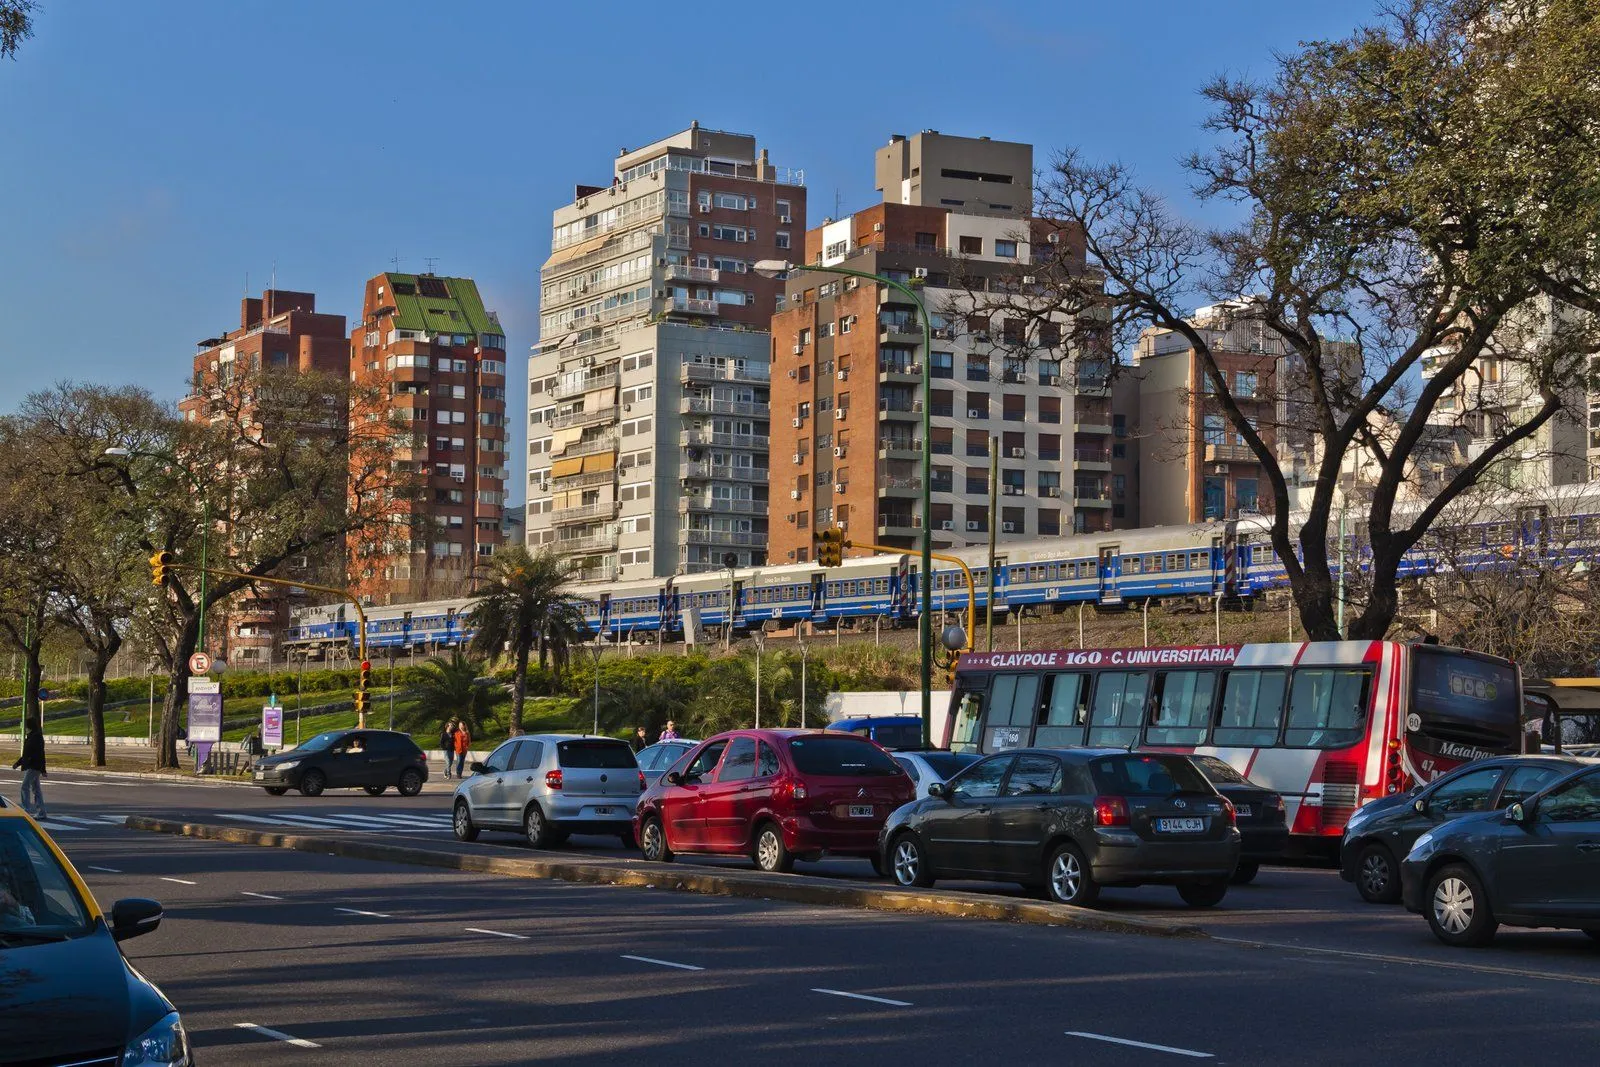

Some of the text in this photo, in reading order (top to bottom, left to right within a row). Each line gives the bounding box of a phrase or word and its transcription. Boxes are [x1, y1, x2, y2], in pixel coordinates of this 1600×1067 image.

[991, 648, 1235, 667] CLAYPOLE 160 C. UNIVERSITARIA
[1421, 759, 1435, 772] 47
[1162, 819, 1182, 829] 9144
